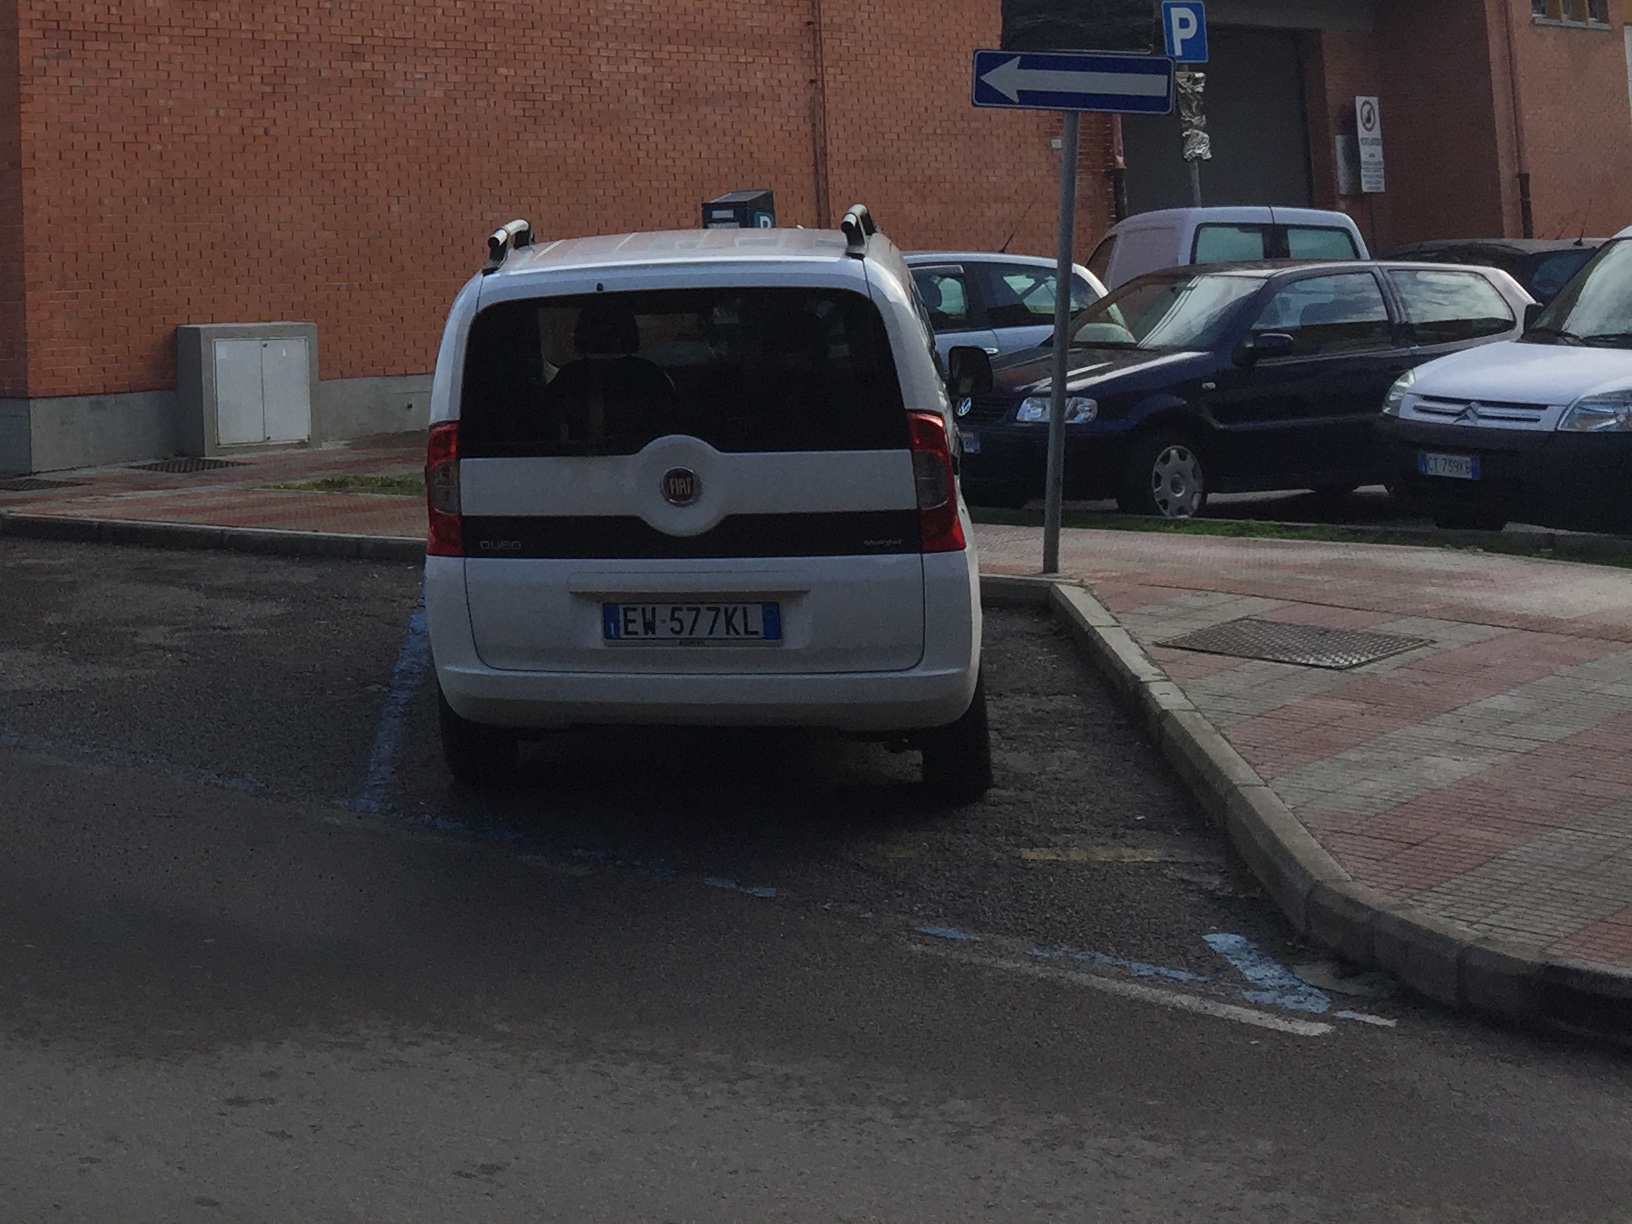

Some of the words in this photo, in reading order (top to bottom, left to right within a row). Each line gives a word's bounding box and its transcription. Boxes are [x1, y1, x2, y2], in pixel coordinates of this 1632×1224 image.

[1171, 7, 1197, 56] P
[669, 478, 692, 495] FIAT
[623, 606, 656, 636] EW
[670, 606, 760, 636] 577KL
